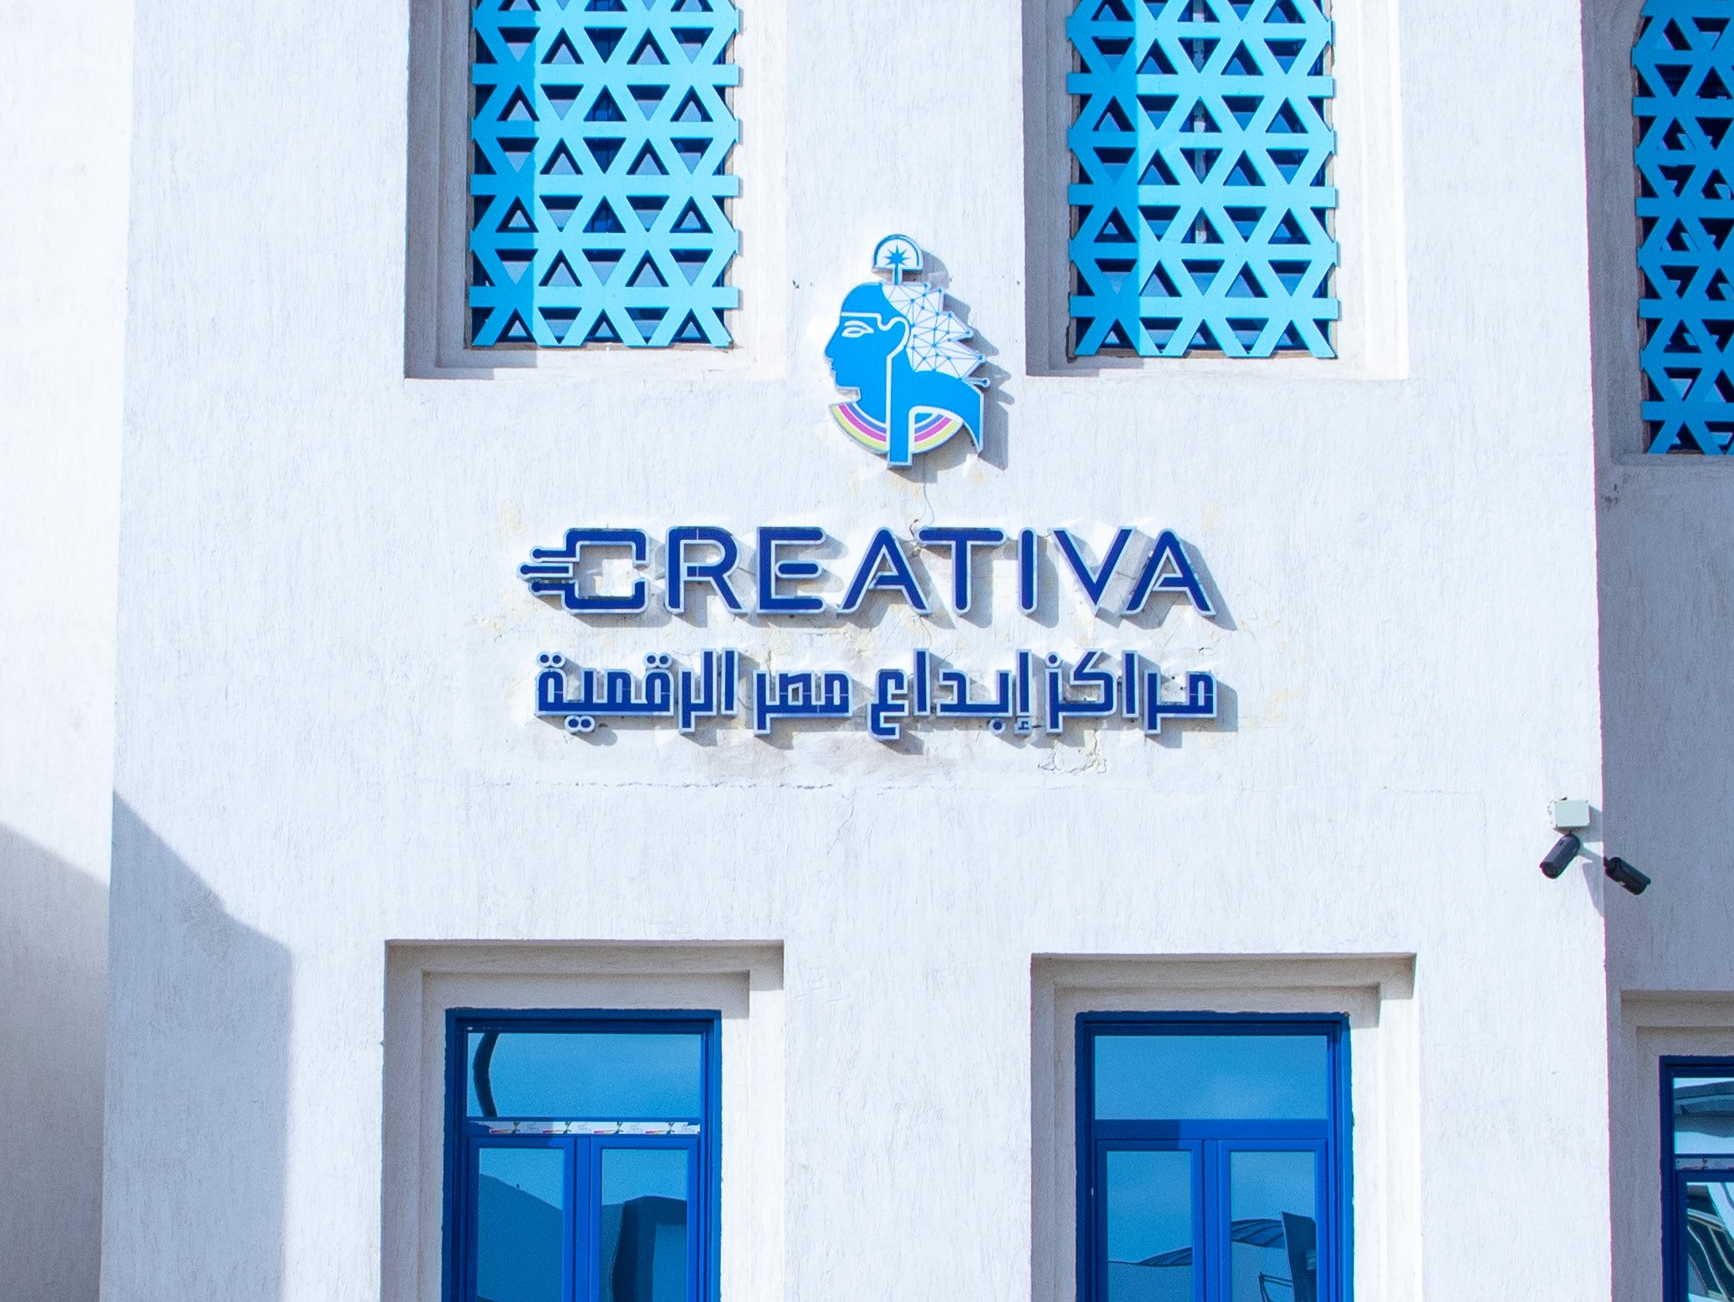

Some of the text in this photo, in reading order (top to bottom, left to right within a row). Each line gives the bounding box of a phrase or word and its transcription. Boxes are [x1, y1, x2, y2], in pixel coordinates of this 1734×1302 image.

[516, 525, 1217, 617] CREATIVA
[535, 647, 1218, 742] مراكز إبداع مصر الرقمية
